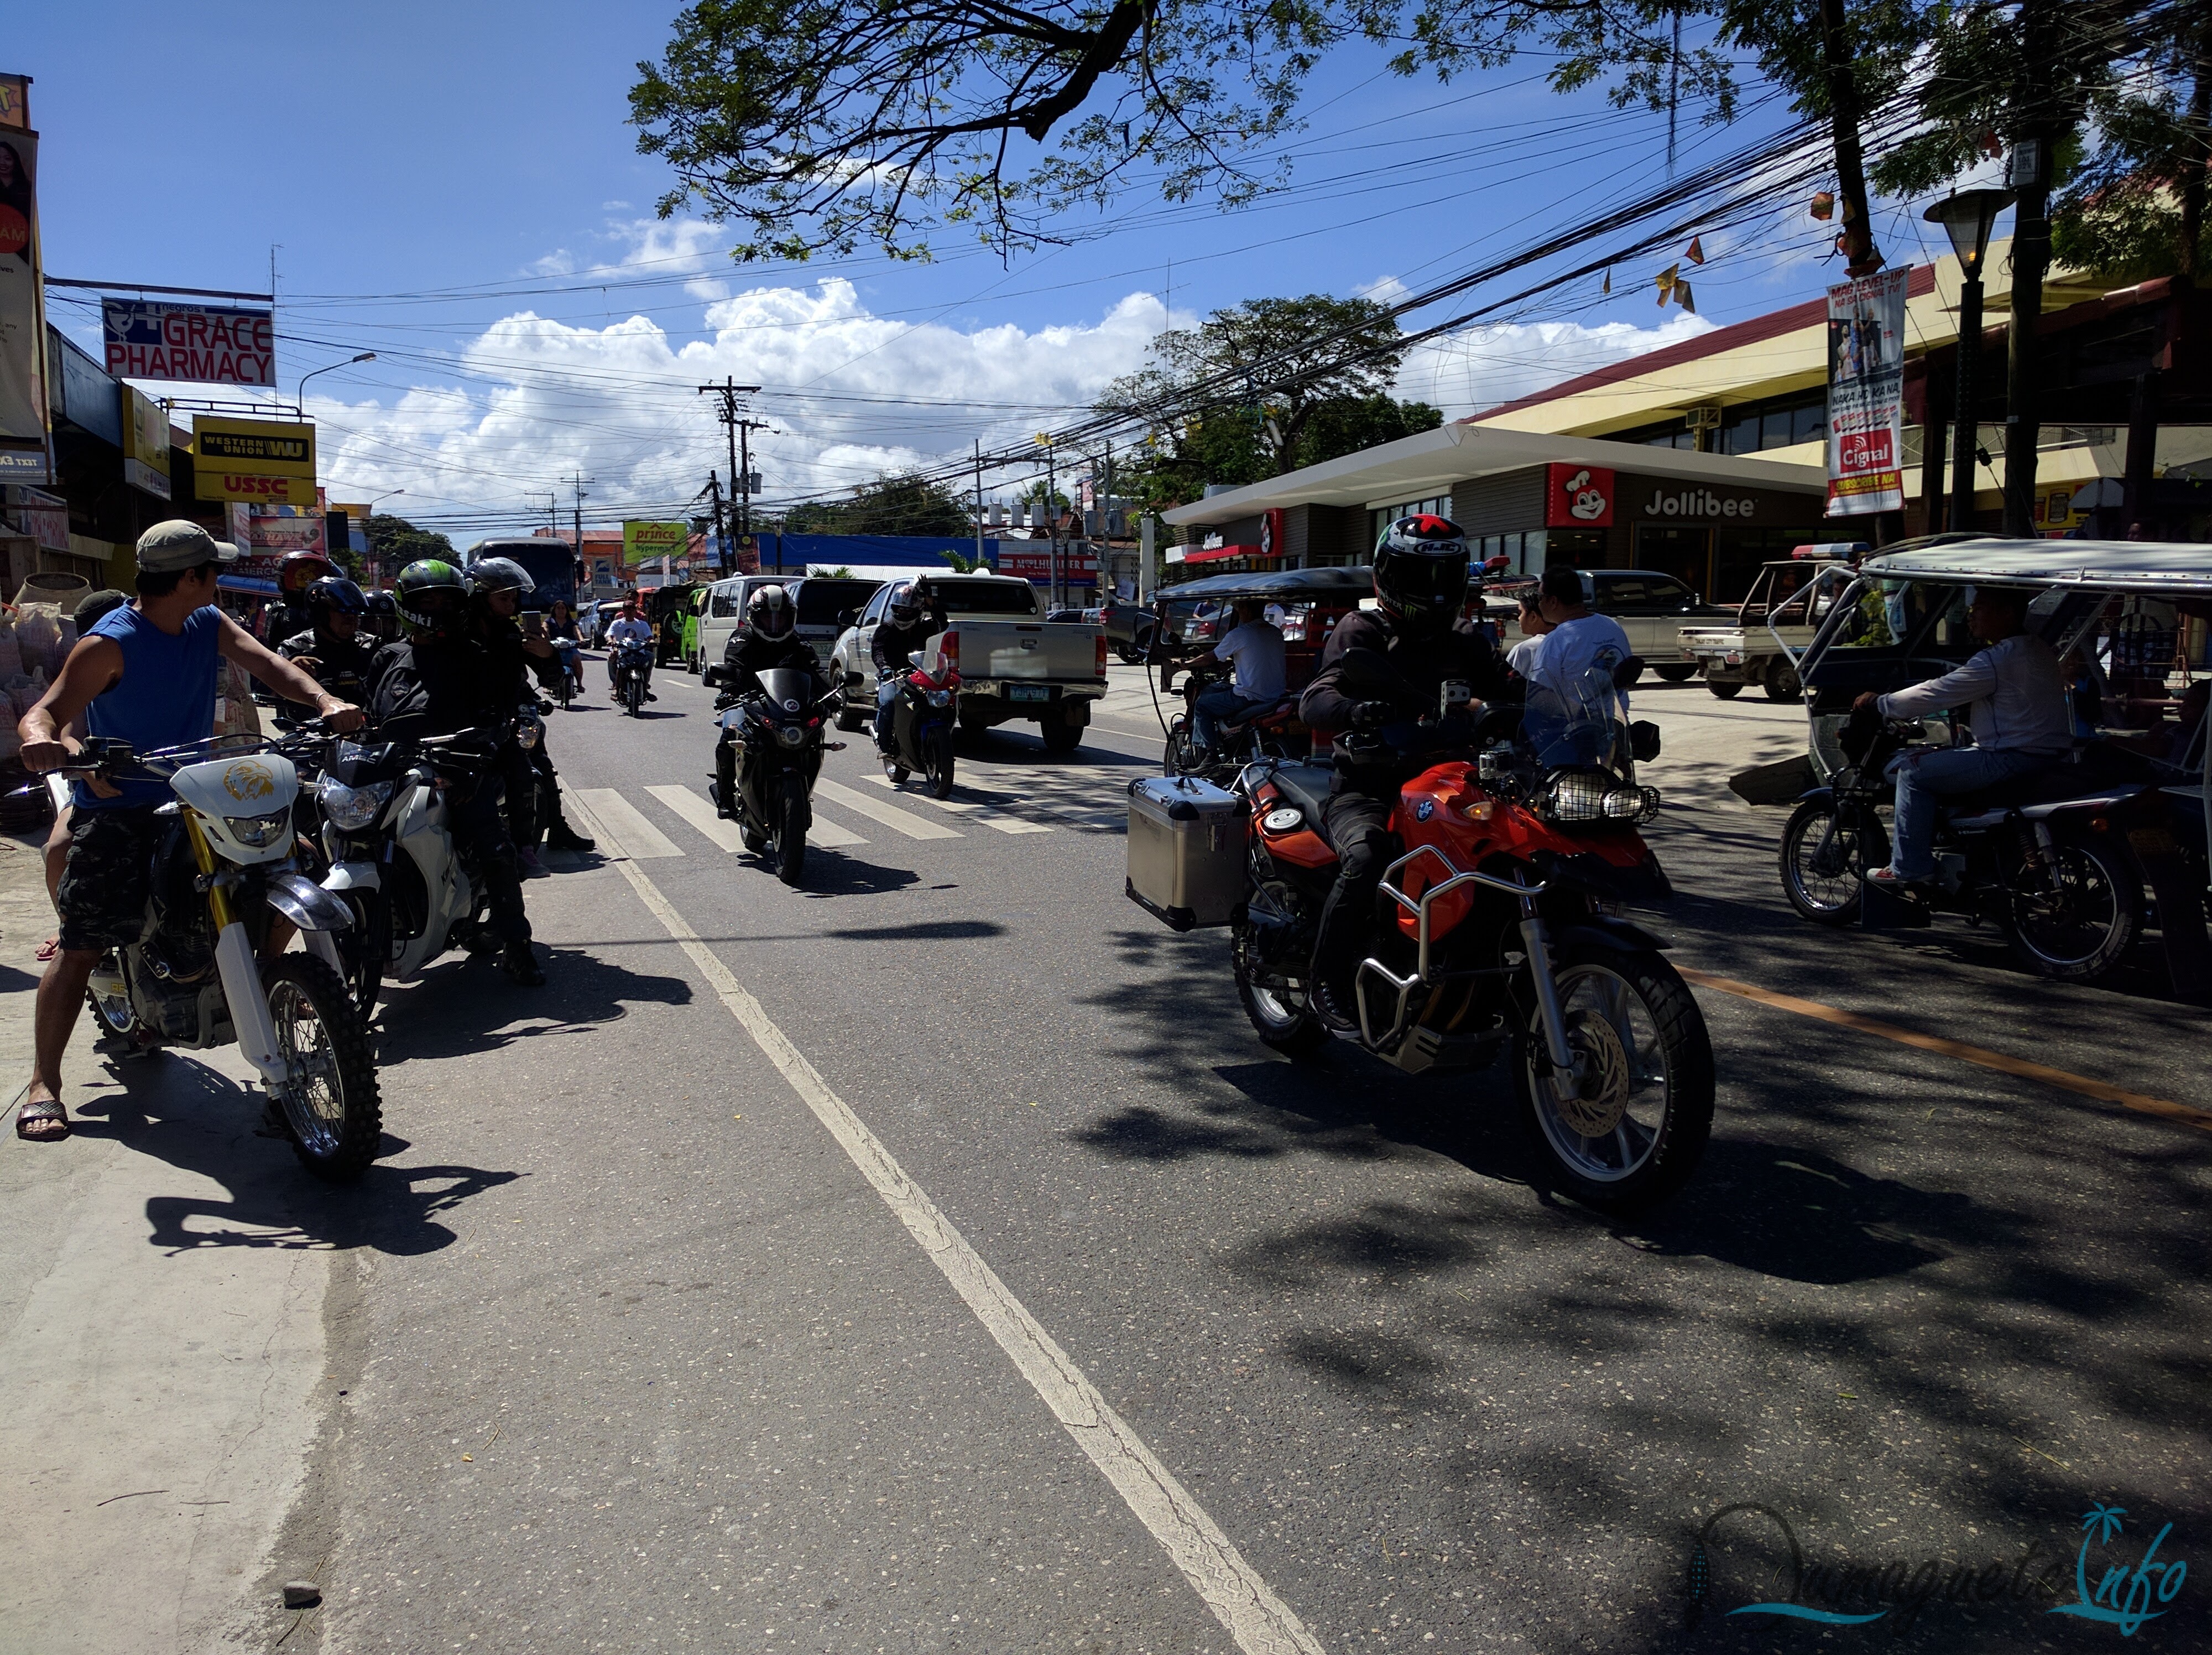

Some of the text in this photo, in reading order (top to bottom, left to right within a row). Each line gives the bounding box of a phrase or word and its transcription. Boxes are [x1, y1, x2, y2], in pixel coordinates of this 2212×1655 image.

[1831, 269, 1905, 299] MAG LEVEL-UP
[162, 304, 201, 313] negros
[163, 313, 272, 352] GRACE
[106, 343, 272, 383] PHARMACY
[1832, 392, 1854, 406] NAKA
[204, 435, 264, 447] WESTERN
[270, 440, 303, 457] WU
[223, 445, 264, 455] UNION
[1843, 447, 1888, 469] Cignal
[224, 475, 289, 495] USSC
[1881, 473, 1896, 485] NA
[1644, 488, 1755, 518] Jollibee
[636, 528, 676, 541] prince
[1421, 543, 1455, 551] HJC
